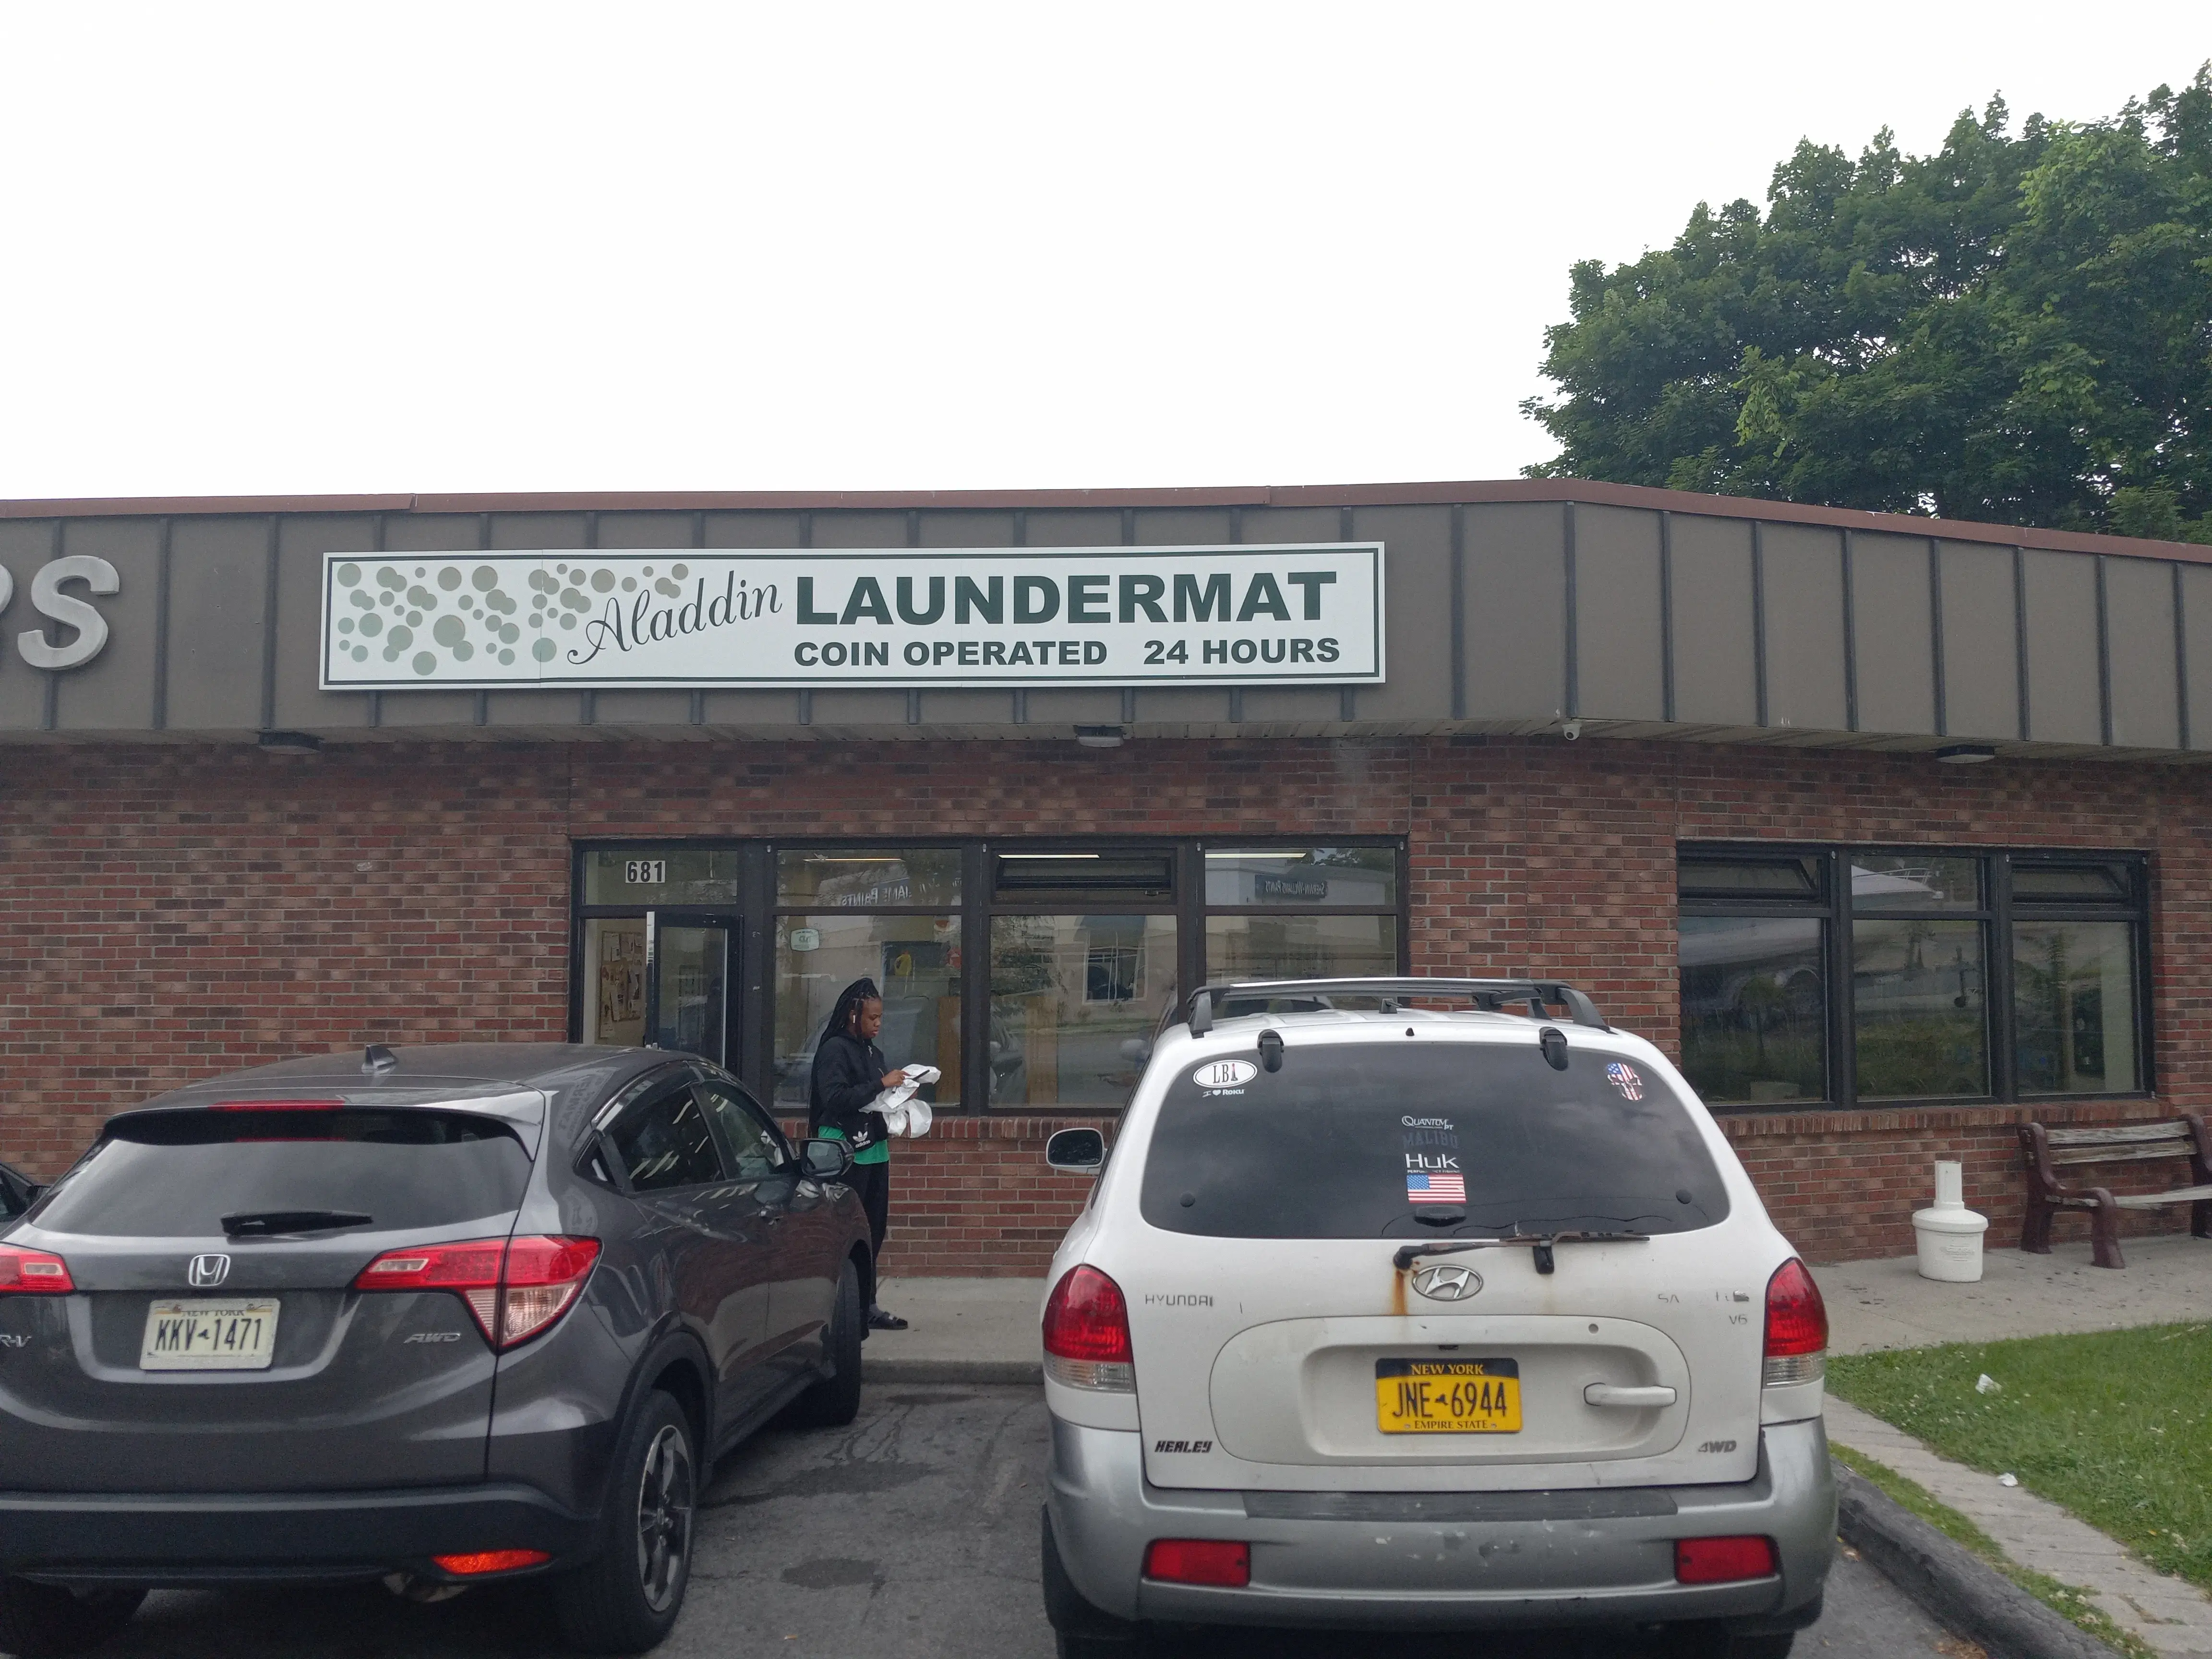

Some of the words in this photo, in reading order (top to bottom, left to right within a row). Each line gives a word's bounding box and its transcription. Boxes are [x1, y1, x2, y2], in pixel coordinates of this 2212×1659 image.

[0, 555, 120, 670] S
[567, 571, 782, 665] Aladdin
[796, 571, 1337, 625] LAUNDERMAT
[794, 642, 889, 666] COIN
[903, 641, 1107, 666] OPERATED
[1143, 640, 1189, 665] 24
[1202, 637, 1340, 664] HOURS
[627, 861, 663, 882] 681
[855, 1140, 871, 1148] adidas
[1405, 1154, 1460, 1168] Huk
[1144, 1294, 1214, 1307] HYUNDAI
[403, 1333, 461, 1345] AWD
[1411, 1364, 1445, 1375] NEW
[1447, 1363, 1484, 1375] YORK
[1414, 1420, 1454, 1430] EMPIRE
[1456, 1419, 1488, 1429] STATE
[1698, 1440, 1737, 1453] 4WD
